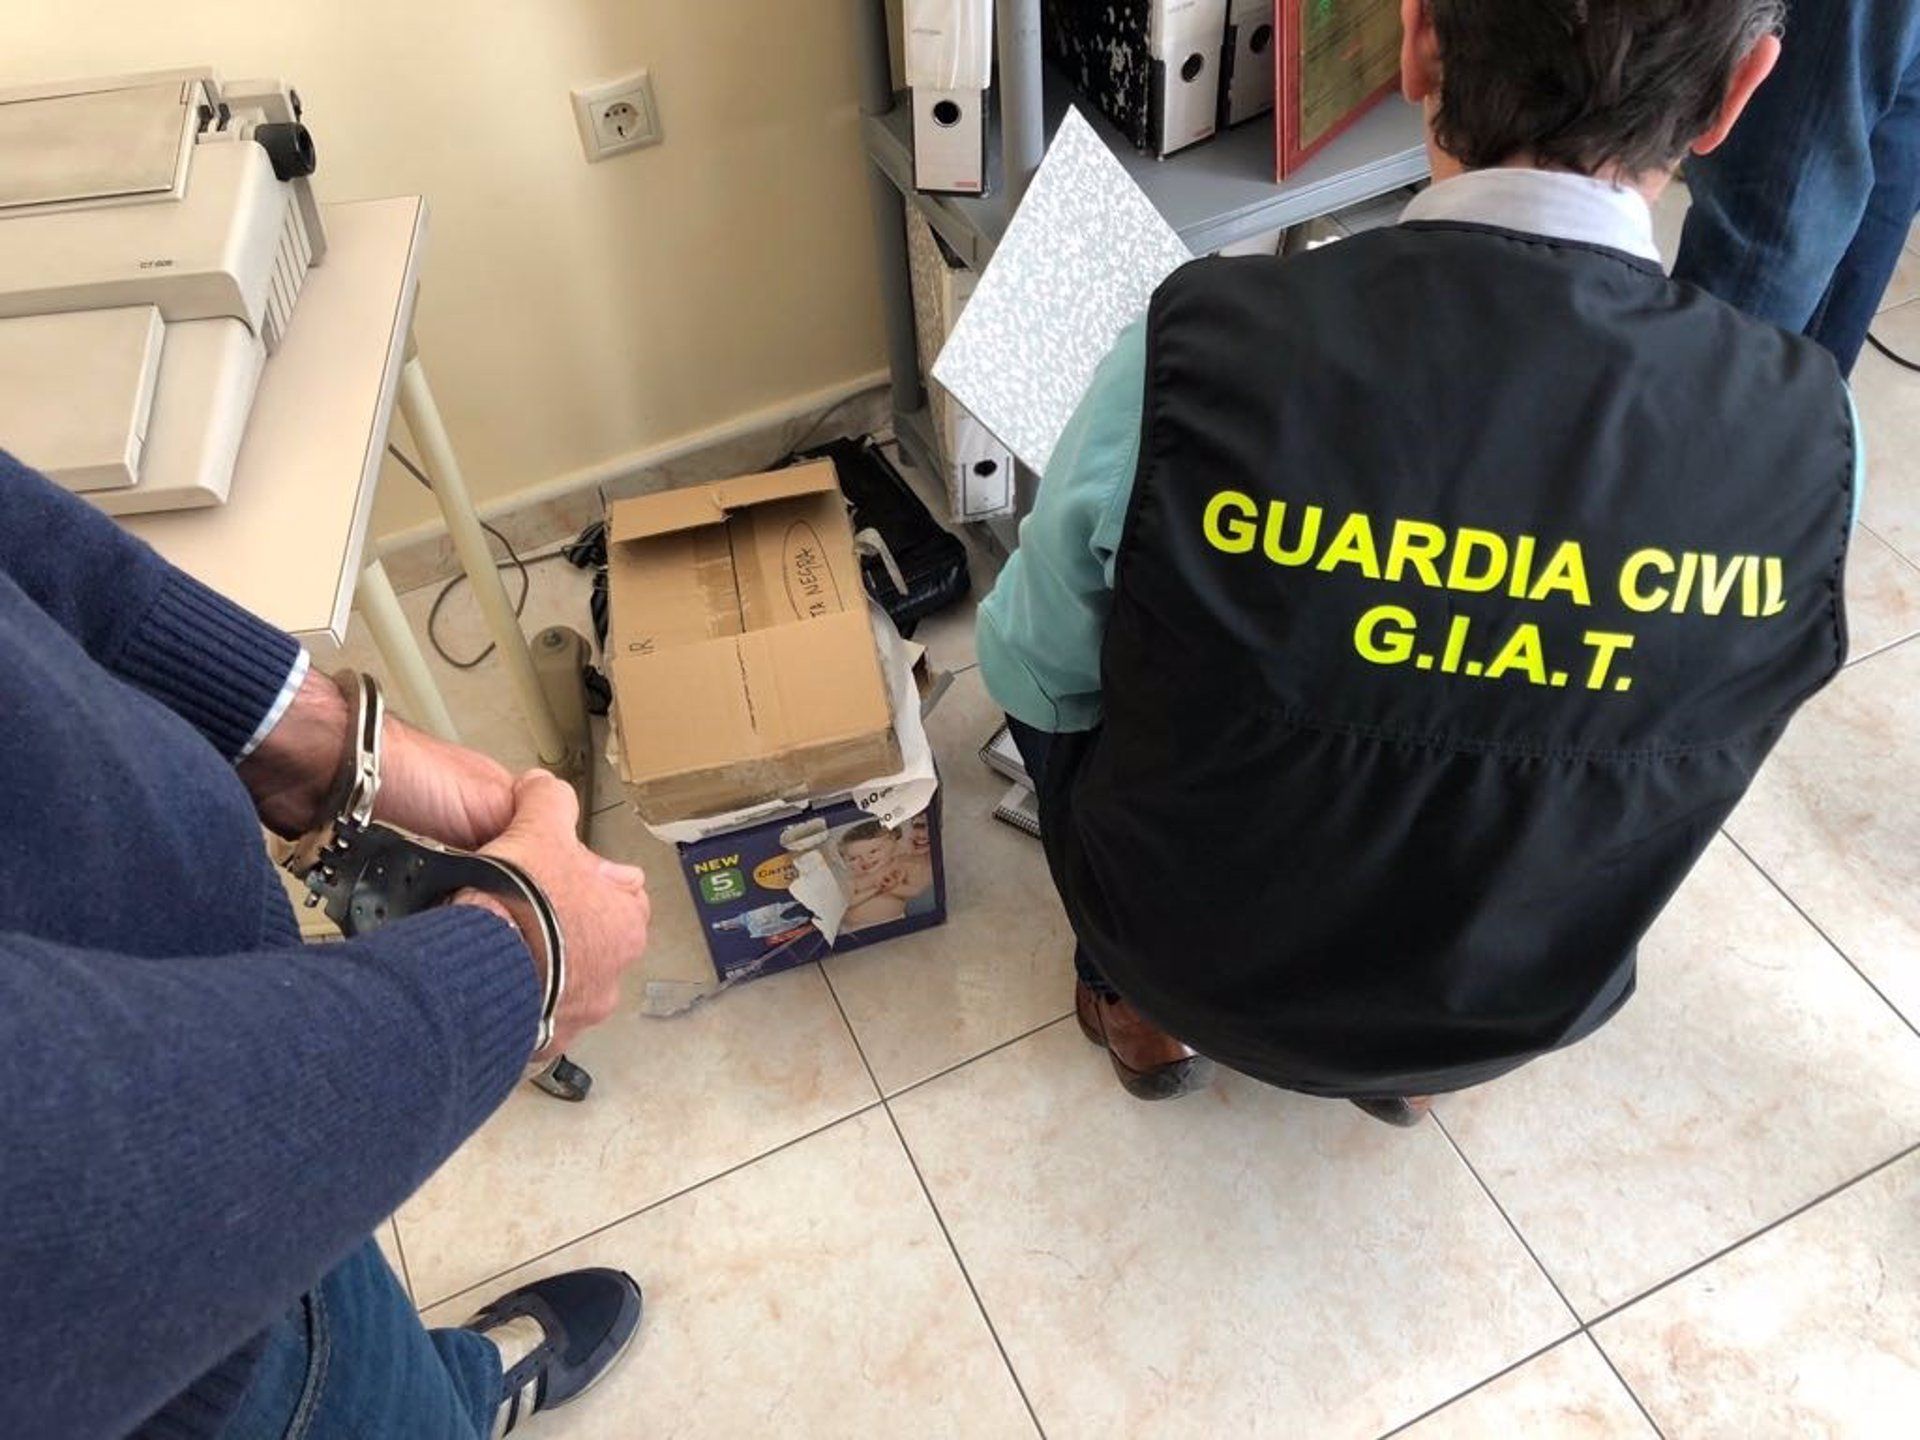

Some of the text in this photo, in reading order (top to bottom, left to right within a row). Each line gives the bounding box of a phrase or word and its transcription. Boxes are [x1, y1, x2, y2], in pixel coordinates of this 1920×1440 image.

[1203, 490, 1786, 617] GUARDIA CIVIL
[1354, 605, 1635, 691] G.I.A.T.
[693, 853, 740, 875] NEW
[710, 872, 734, 892] 5
